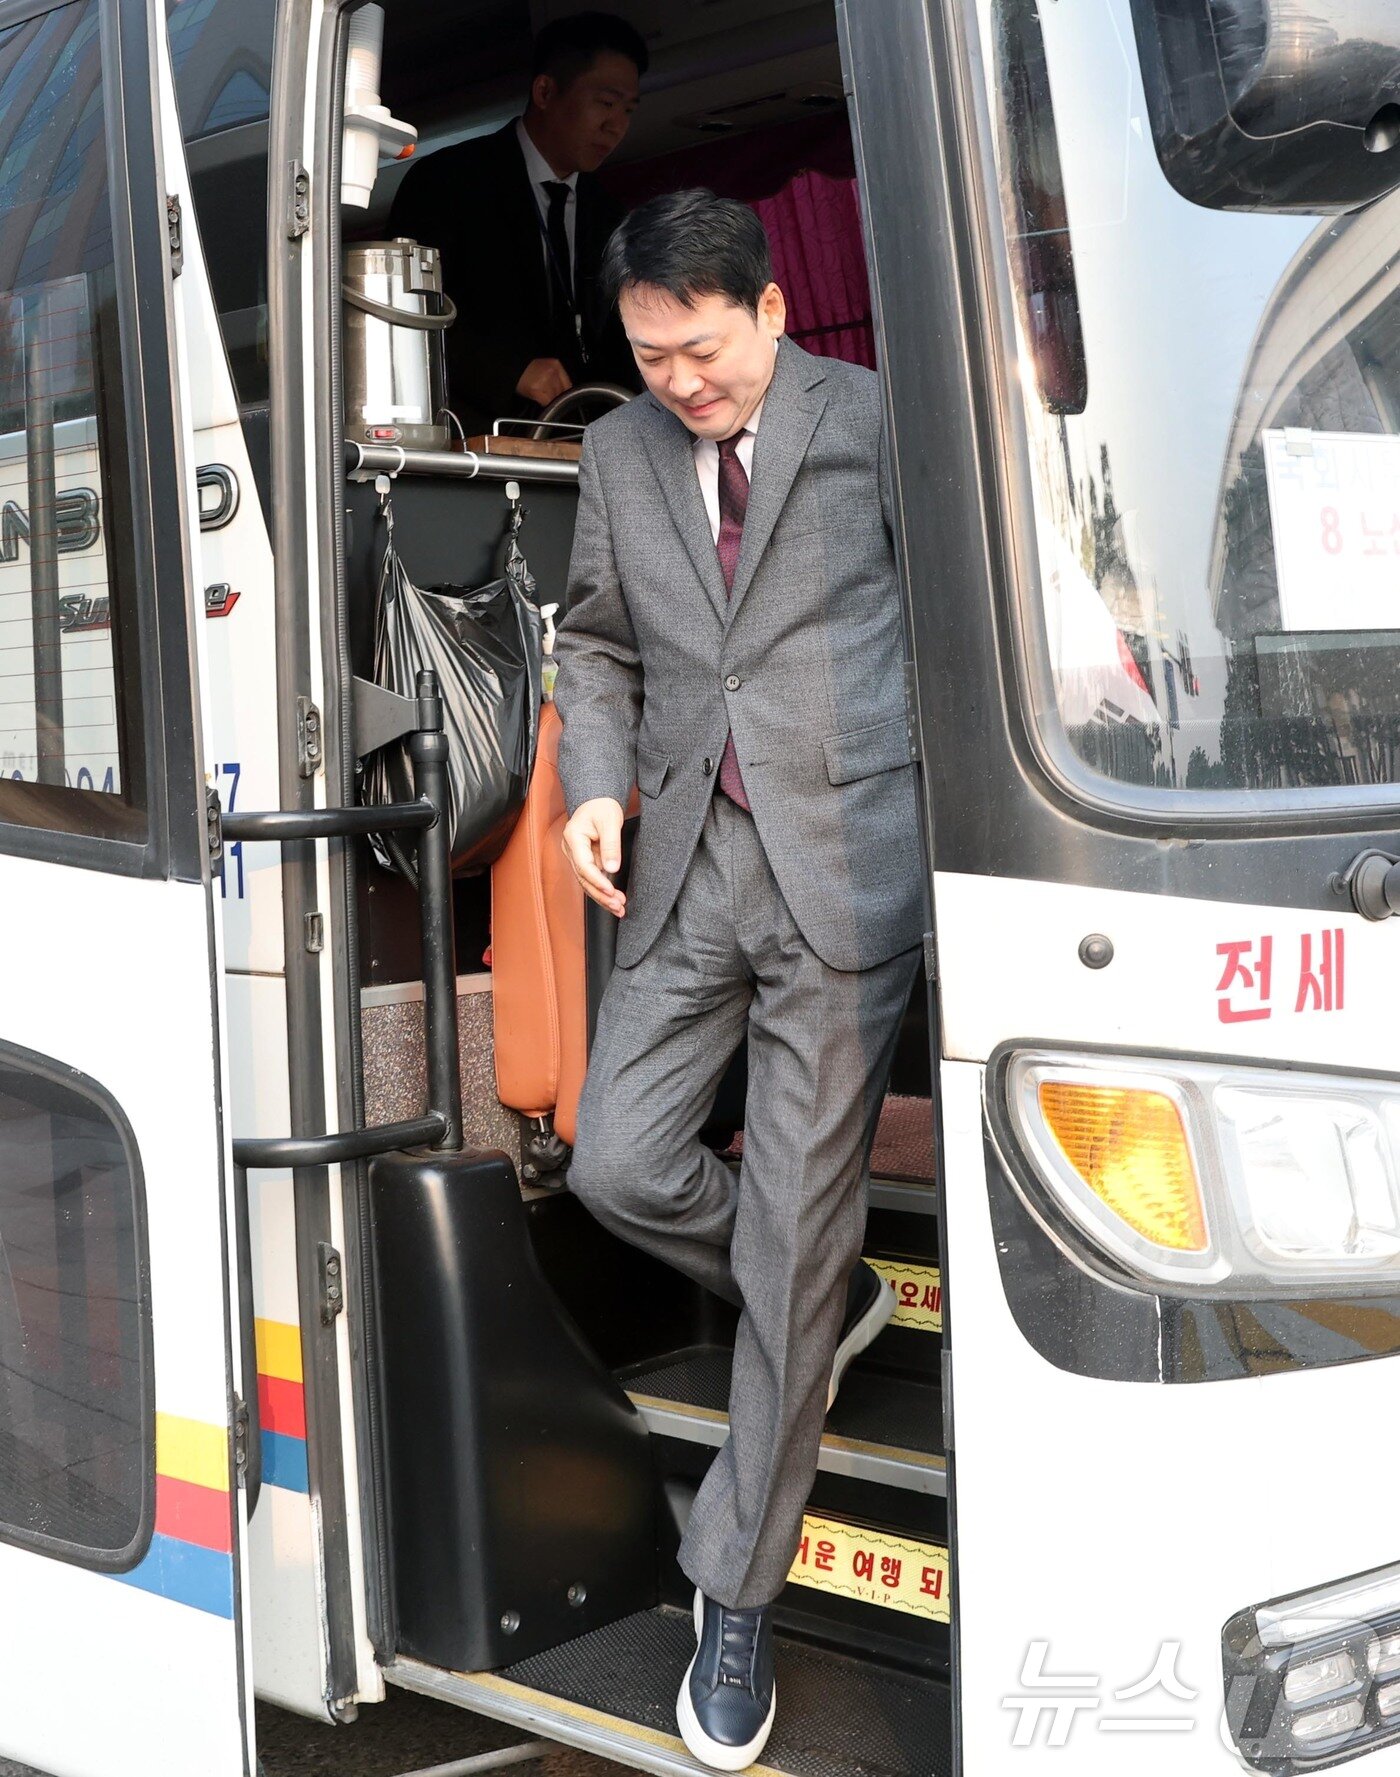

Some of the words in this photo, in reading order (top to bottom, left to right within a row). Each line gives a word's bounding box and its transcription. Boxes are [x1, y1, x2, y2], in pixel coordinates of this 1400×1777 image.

[1320, 505, 1343, 555] 8
[890, 1279, 942, 1314] 오세
[853, 1550, 902, 1588] 여행
[919, 1566, 943, 1600] 되
